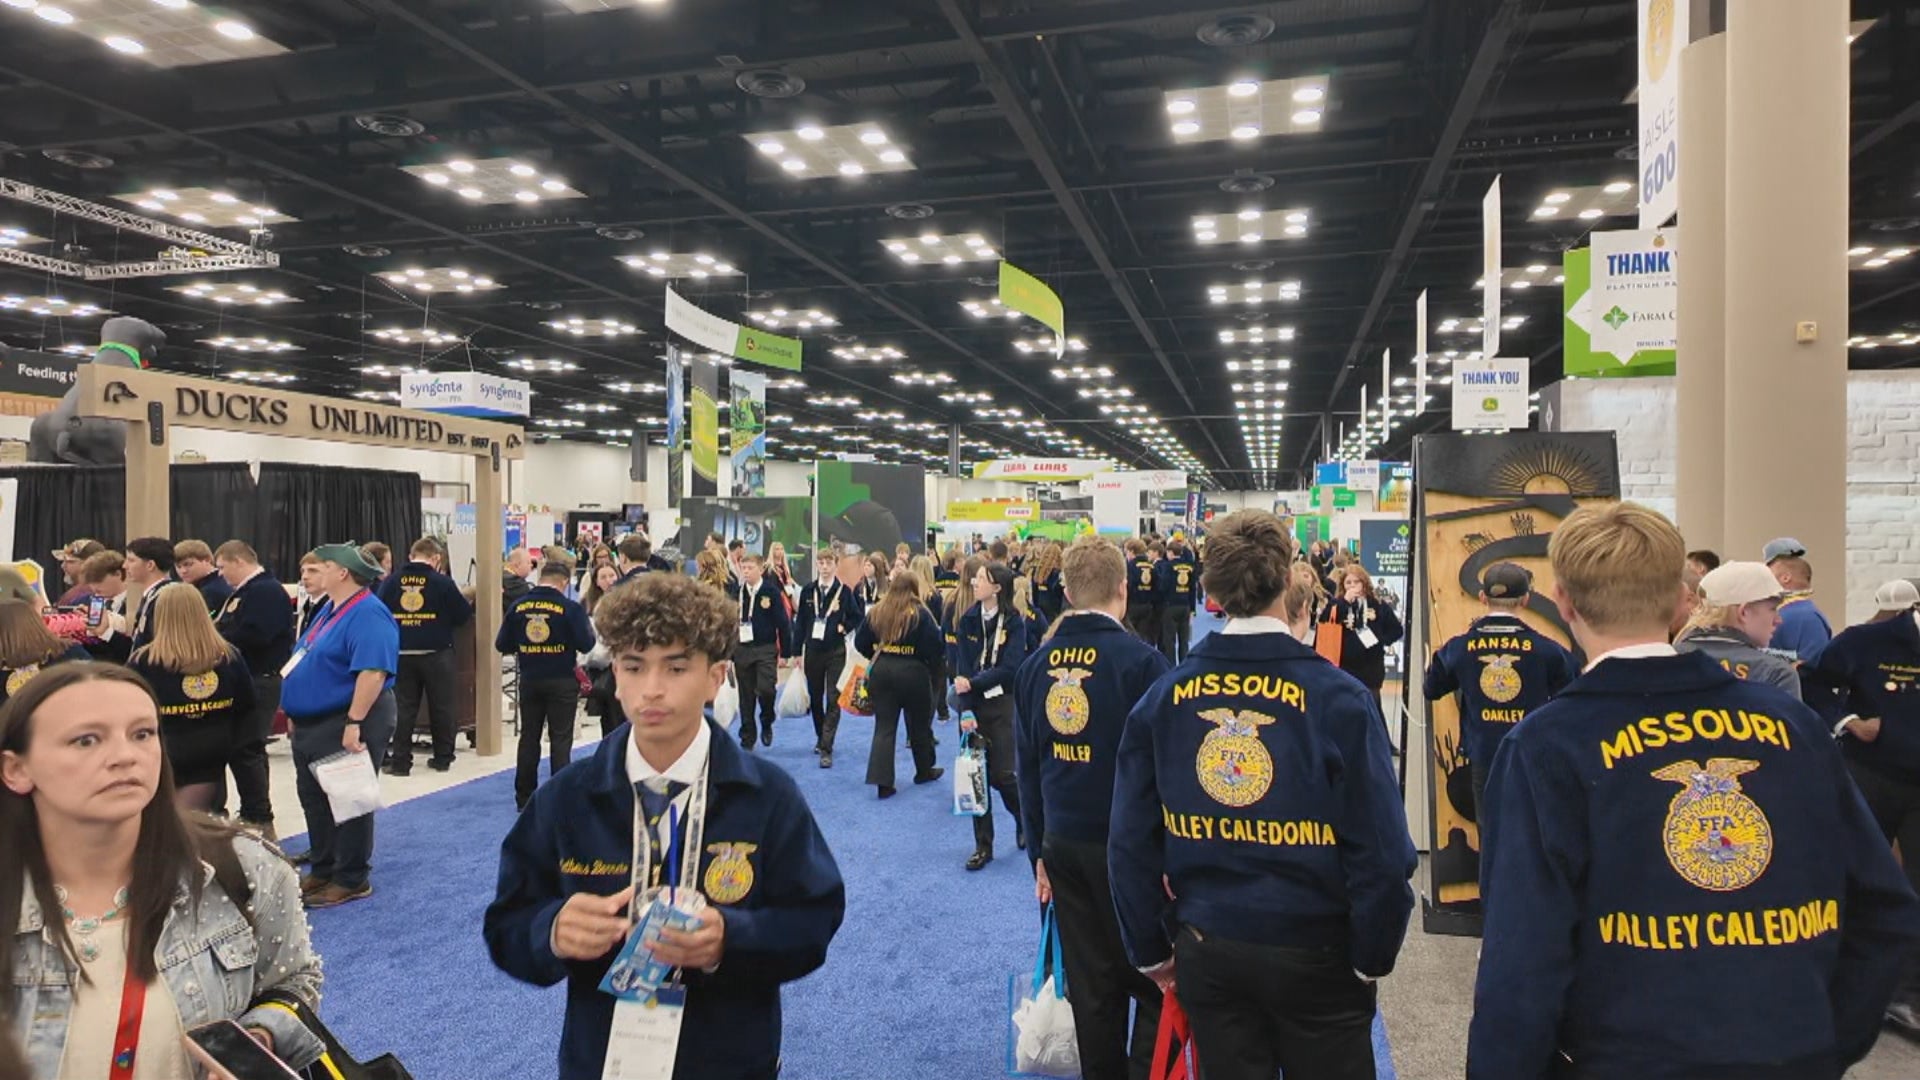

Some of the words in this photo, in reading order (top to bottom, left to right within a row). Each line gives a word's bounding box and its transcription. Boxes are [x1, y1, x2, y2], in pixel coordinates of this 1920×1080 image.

[1643, 97, 1675, 154] AISLE
[1643, 140, 1676, 204] 600
[1606, 251, 1671, 276] THANK
[1632, 311, 1666, 322] FARM
[18, 363, 67, 383] Feeding
[1462, 372, 1496, 385] THANK
[1498, 372, 1520, 385] YOU
[409, 379, 462, 396] syngenta
[479, 383, 523, 401] syngenta
[176, 387, 289, 426] DUCKS
[310, 404, 444, 443] UNLIMITED
[1033, 463, 1068, 473] CLAAS
[401, 576, 426, 585] OHIO
[901, 645, 915, 655] CITY
[1467, 636, 1532, 652] KANSAS
[1049, 647, 1097, 666] OHIO
[1173, 673, 1306, 713] MISSOURI
[160, 703, 200, 715] HARVEST
[1481, 708, 1525, 723] OAKLEY
[1600, 709, 1791, 769] MISSOURI
[1053, 742, 1091, 762] MILLER
[1220, 749, 1247, 763] FFA
[1219, 818, 1336, 846] CALEDONIA
[1698, 816, 1737, 831] FFA
[1599, 911, 1699, 950] VALLEY
